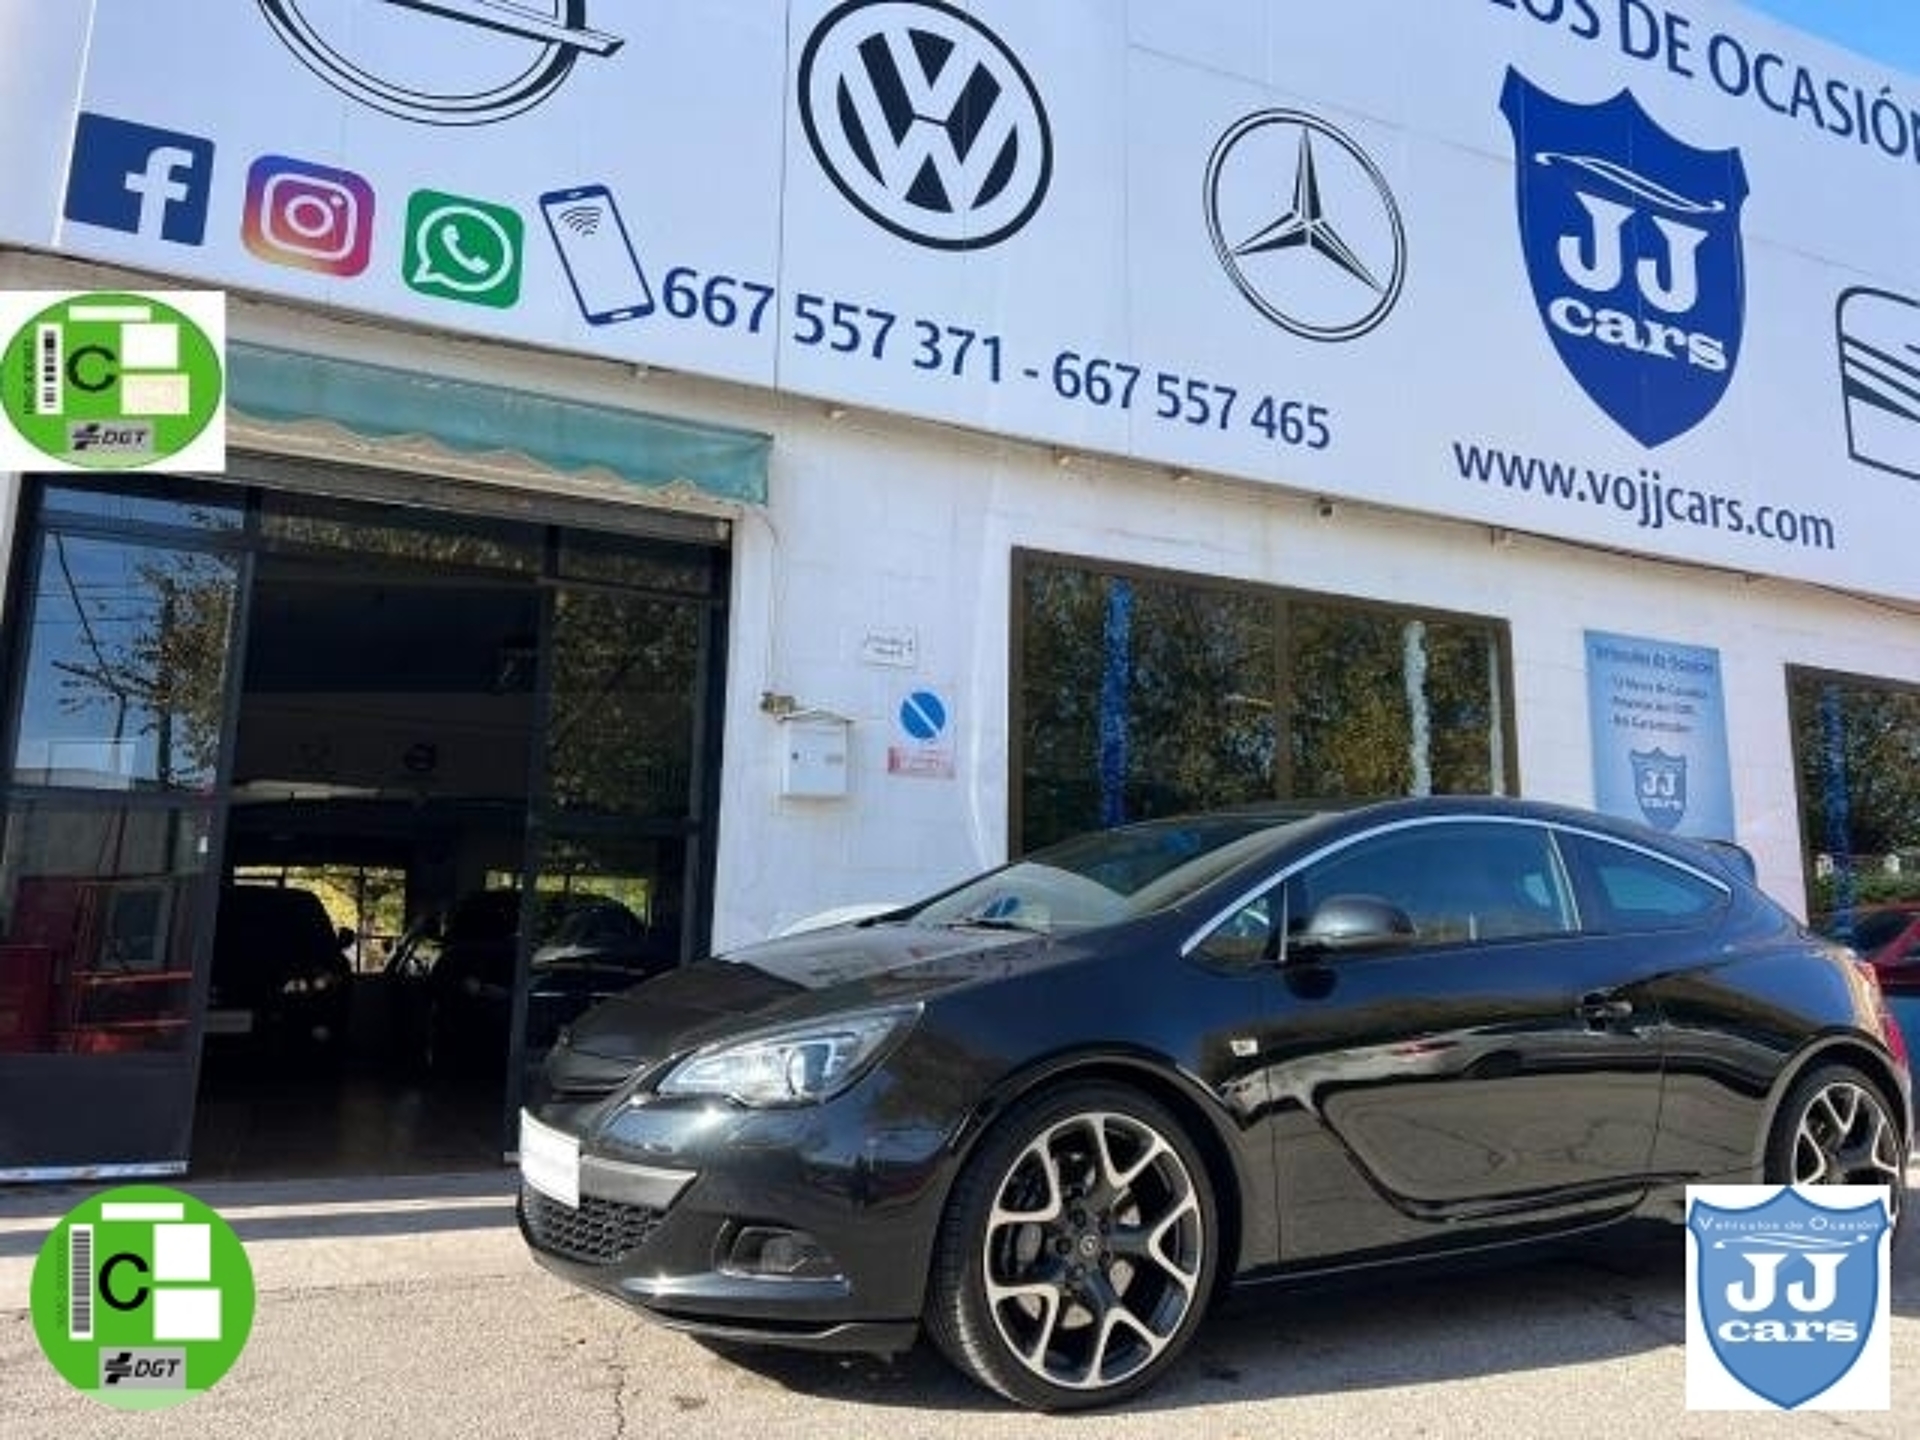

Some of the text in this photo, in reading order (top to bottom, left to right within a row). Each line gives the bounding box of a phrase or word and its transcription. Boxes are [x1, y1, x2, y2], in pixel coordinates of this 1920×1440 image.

[1619, 0, 1920, 164] DE OCASIÓ
[1558, 190, 1709, 313] JJ
[662, 266, 1330, 450] 667 557 371 - 667 557 465
[1548, 296, 1727, 371] cars
[1453, 441, 1835, 549] www.vojjcars.com
